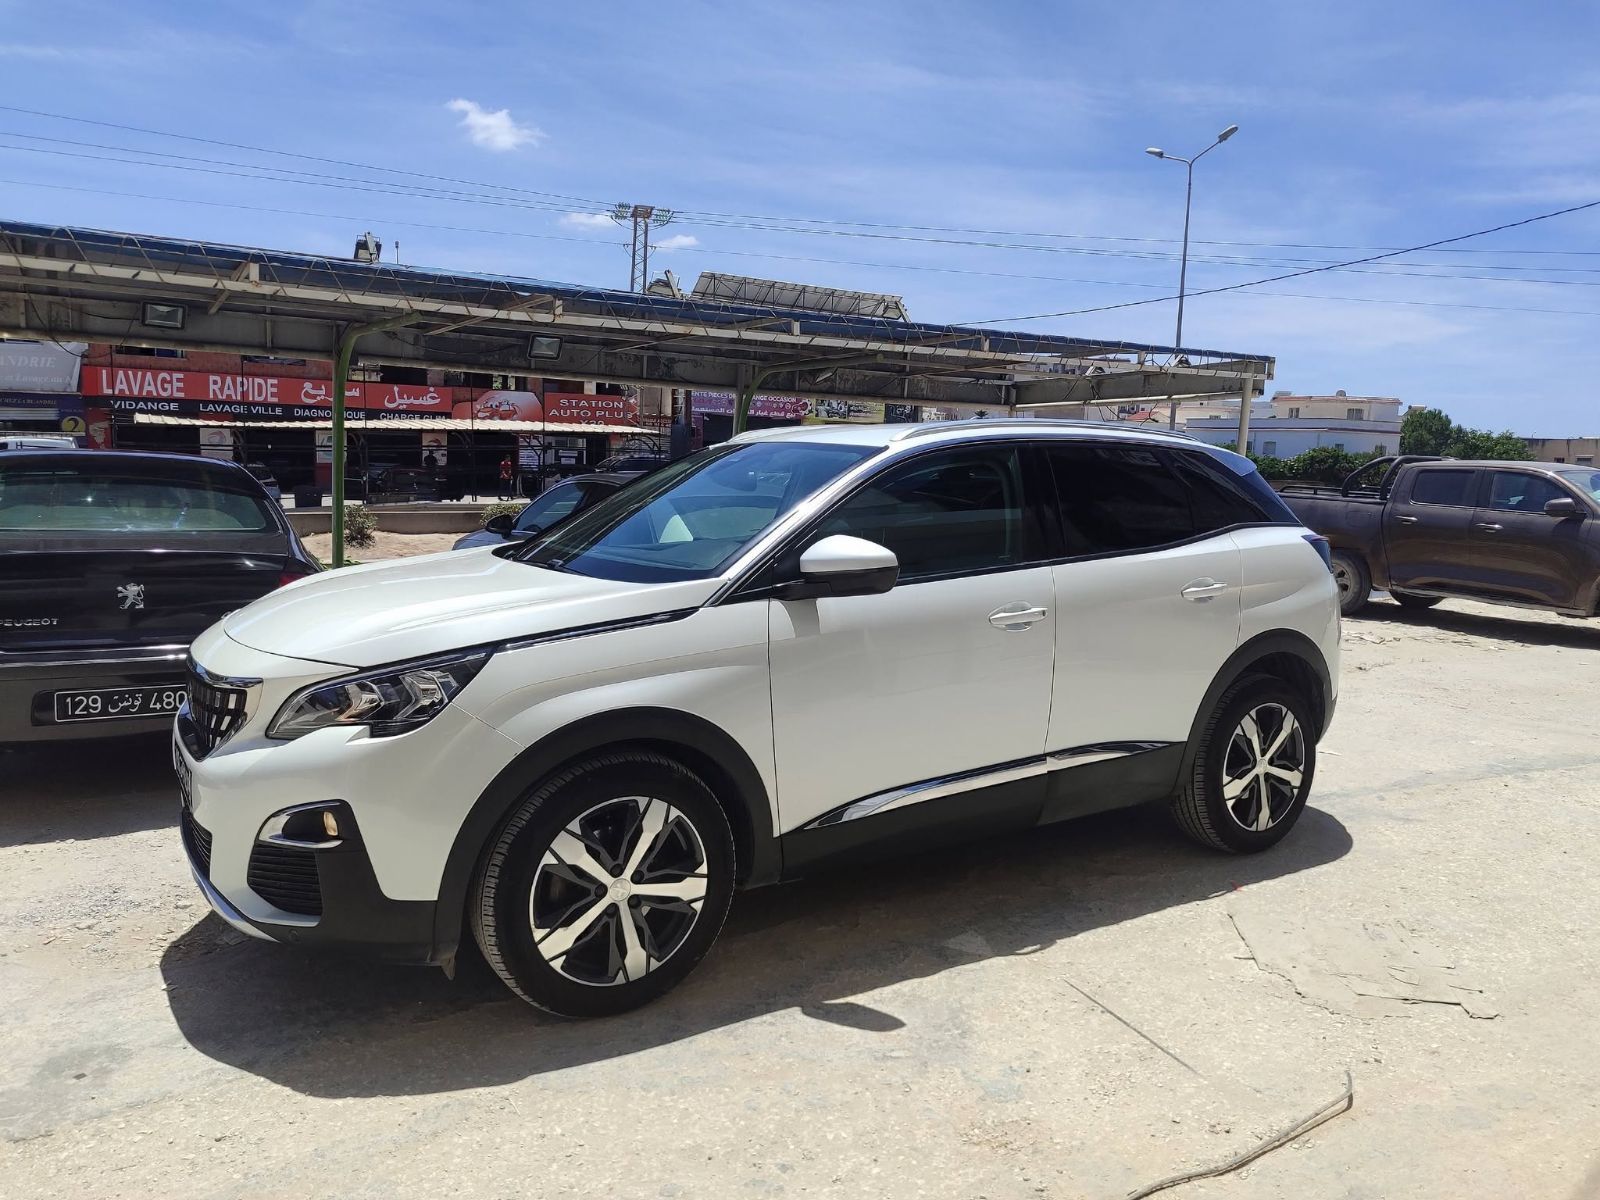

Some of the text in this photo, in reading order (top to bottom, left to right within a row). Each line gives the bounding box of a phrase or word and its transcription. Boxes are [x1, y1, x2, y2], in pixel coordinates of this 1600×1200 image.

[102, 369, 279, 402] LAVAGE RAPIDE
[384, 384, 441, 409] غسيل
[559, 399, 624, 409] STATION
[768, 395, 797, 403] OCCASION
[110, 400, 180, 411] VIDANGE
[199, 403, 248, 414] LAVAGE
[250, 405, 283, 416] VILLE
[294, 408, 366, 419] DIAGNOIQUE
[380, 412, 421, 421] CHARGE
[549, 408, 592, 418] AUTO
[66, 695, 102, 715] 129
[149, 690, 188, 710] 480
